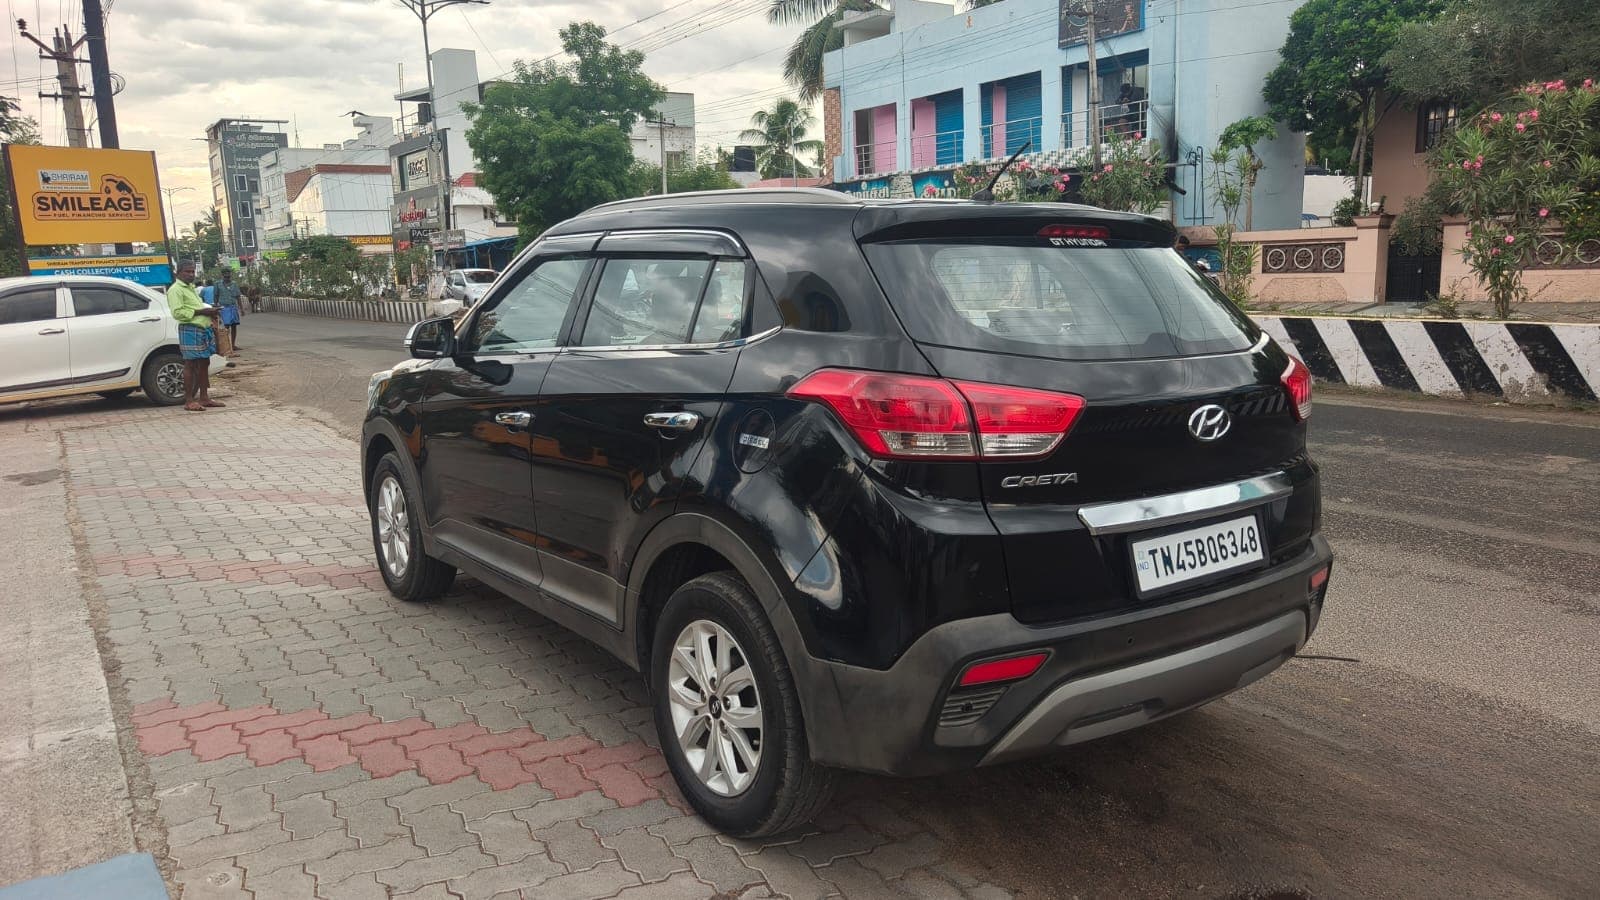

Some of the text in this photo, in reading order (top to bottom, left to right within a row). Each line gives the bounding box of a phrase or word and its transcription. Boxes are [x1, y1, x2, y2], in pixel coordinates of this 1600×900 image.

[50, 172, 88, 182] SHRIRAM
[36, 196, 145, 211] SMILEAGE
[1049, 237, 1108, 247] GT HYUNDAI
[76, 266, 122, 276] COLLECTION
[123, 265, 151, 274] CENTRE
[1001, 472, 1078, 488] CRETA
[1148, 526, 1258, 579] TN45BQ6348
